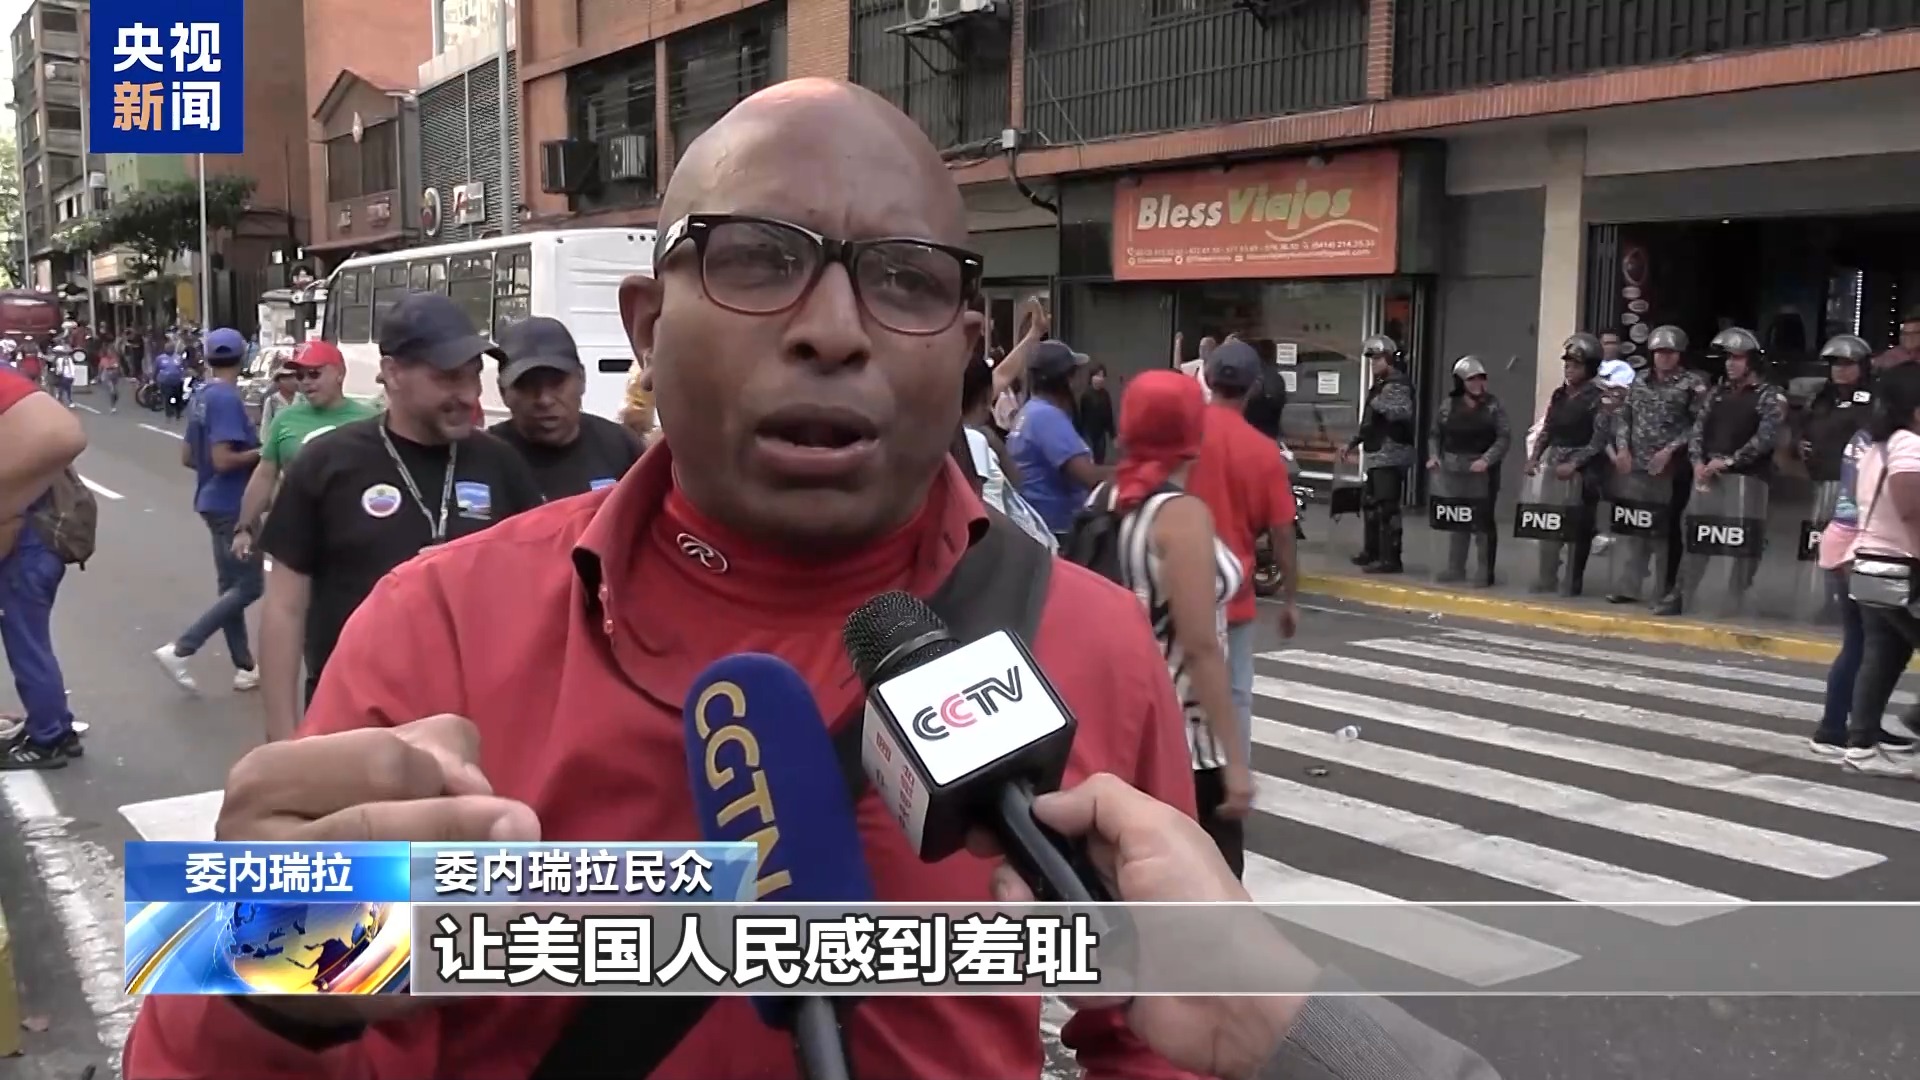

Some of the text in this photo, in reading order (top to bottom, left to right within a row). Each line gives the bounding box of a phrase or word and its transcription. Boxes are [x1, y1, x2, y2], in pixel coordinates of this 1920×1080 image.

[1137, 195, 1223, 230] Bless
[1436, 505, 1472, 522] PNB
[1522, 511, 1561, 530] PNB
[1614, 506, 1652, 528] PNB
[1697, 525, 1744, 546] PNB
[912, 665, 1023, 742] CCTV
[694, 681, 792, 906] CGTN
